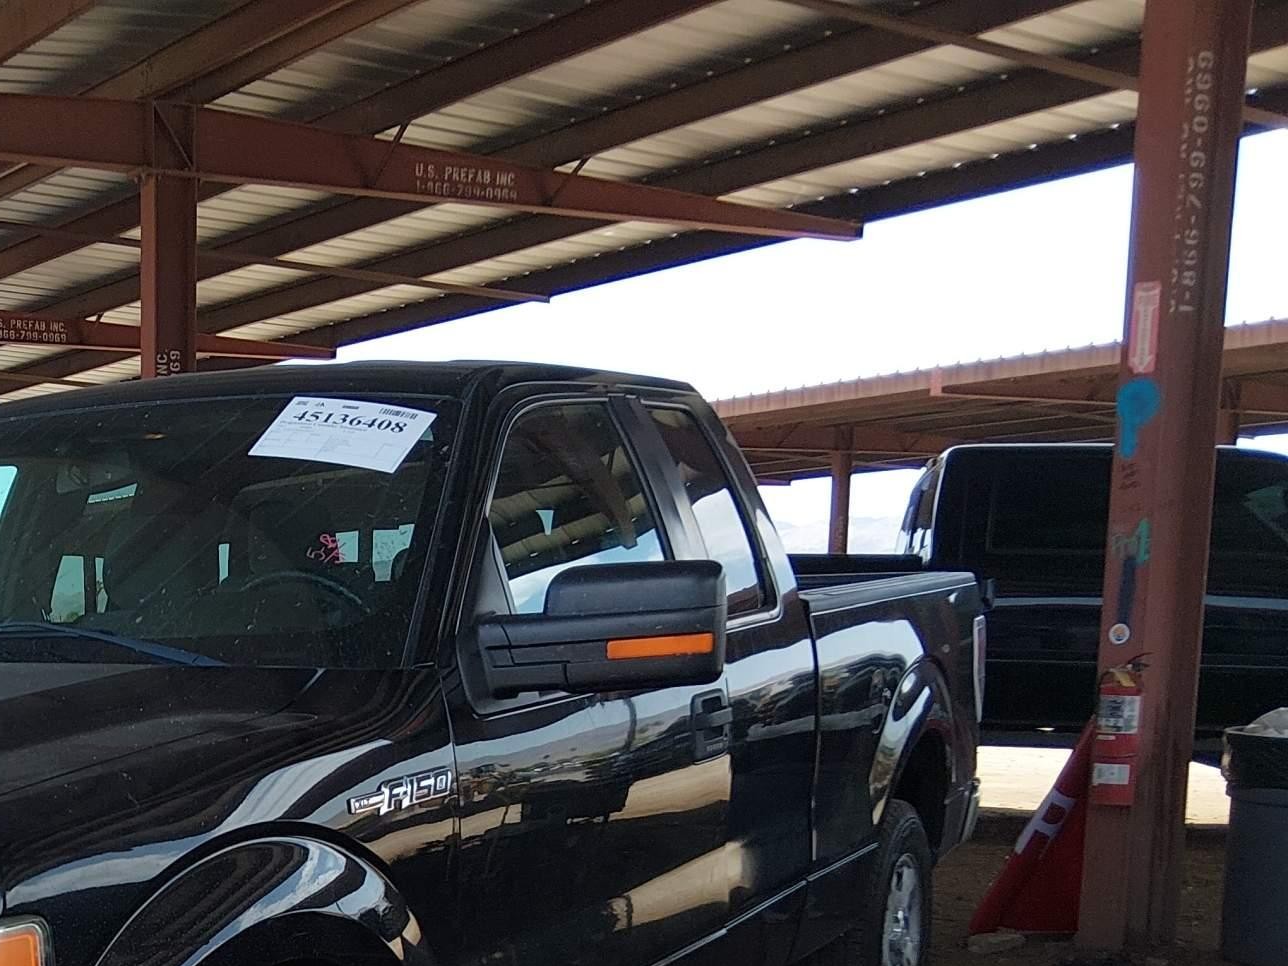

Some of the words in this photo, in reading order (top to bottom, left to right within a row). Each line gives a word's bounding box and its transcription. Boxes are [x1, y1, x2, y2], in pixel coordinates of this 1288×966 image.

[415, 163, 439, 179] U.S.
[445, 166, 491, 184] PREFAB
[1178, 51, 1213, 313] 1-866-799-0969
[10, 319, 46, 331] PREFAB
[50, 321, 67, 333] INC.
[293, 410, 408, 434] 45136408
